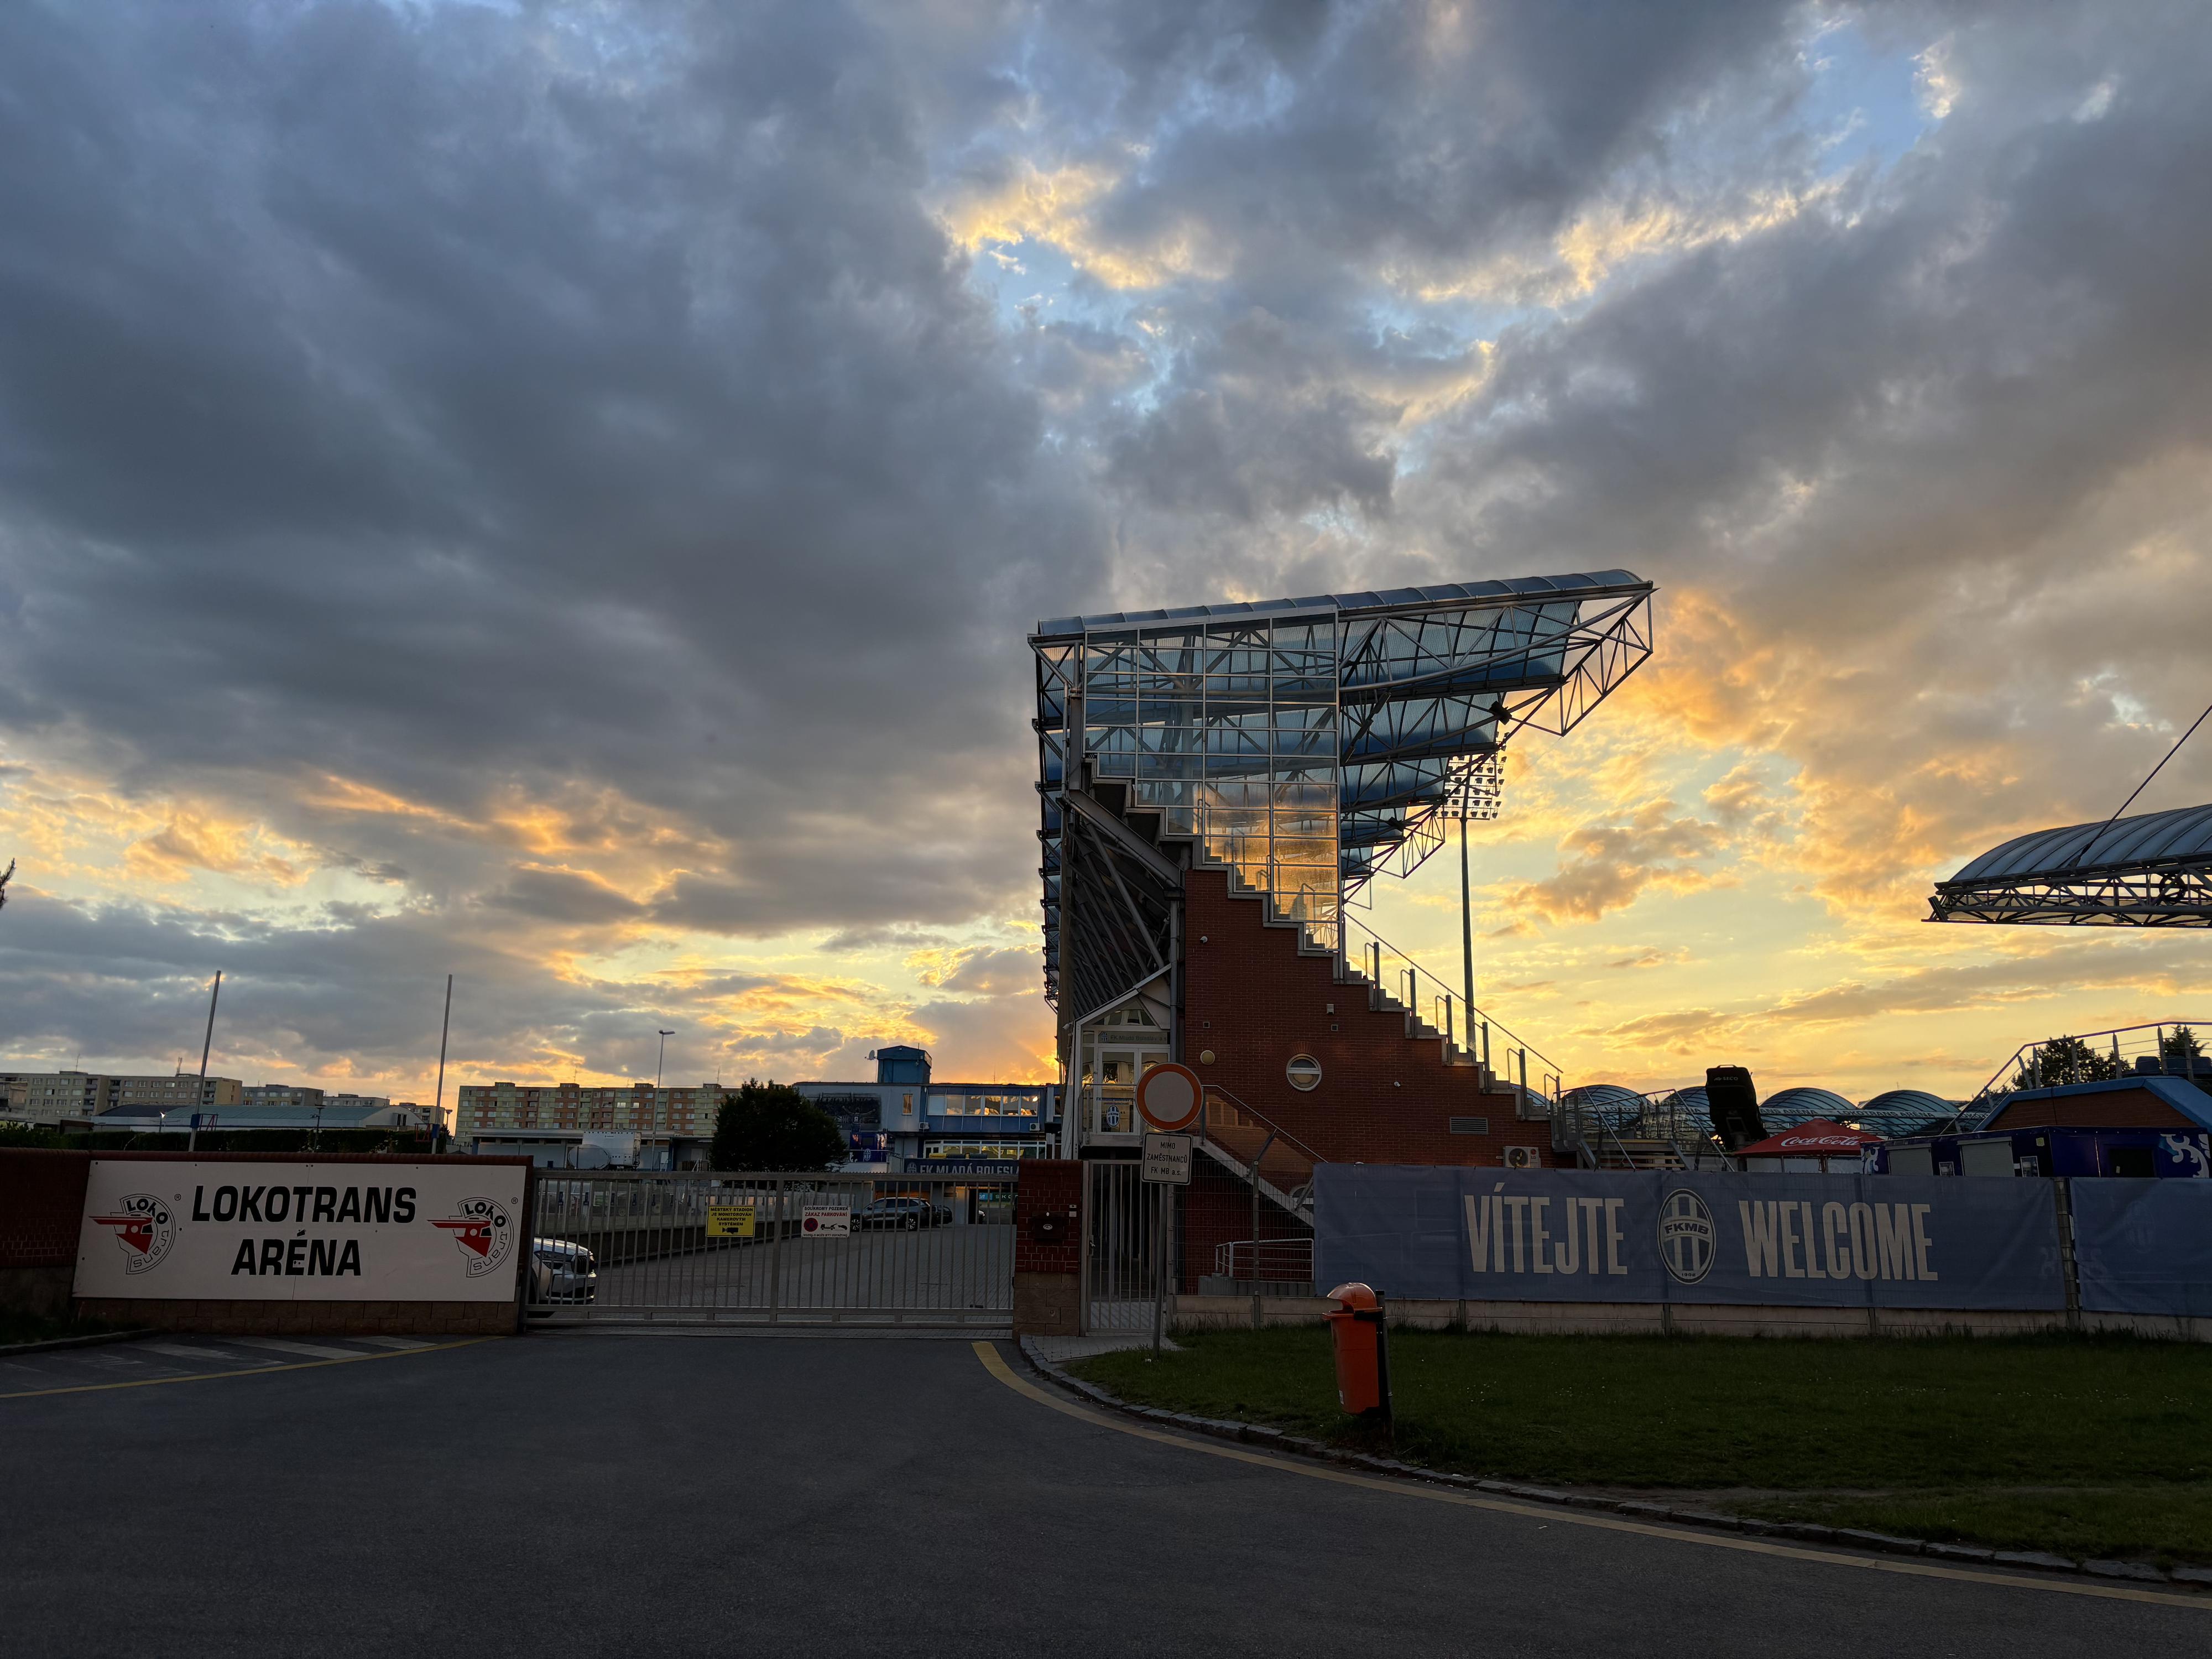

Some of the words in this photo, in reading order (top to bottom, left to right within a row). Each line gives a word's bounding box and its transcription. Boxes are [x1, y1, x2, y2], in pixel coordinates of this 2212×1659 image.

[1781, 1135, 1863, 1147] Coca-Cola
[192, 1185, 417, 1223] LOKOTRANS
[1464, 1182, 1628, 1275] VÍTEJTE
[1665, 1223, 1709, 1234] FKMB
[1739, 1200, 1938, 1281] WELCOME
[231, 1229, 362, 1276] ARÉNA
